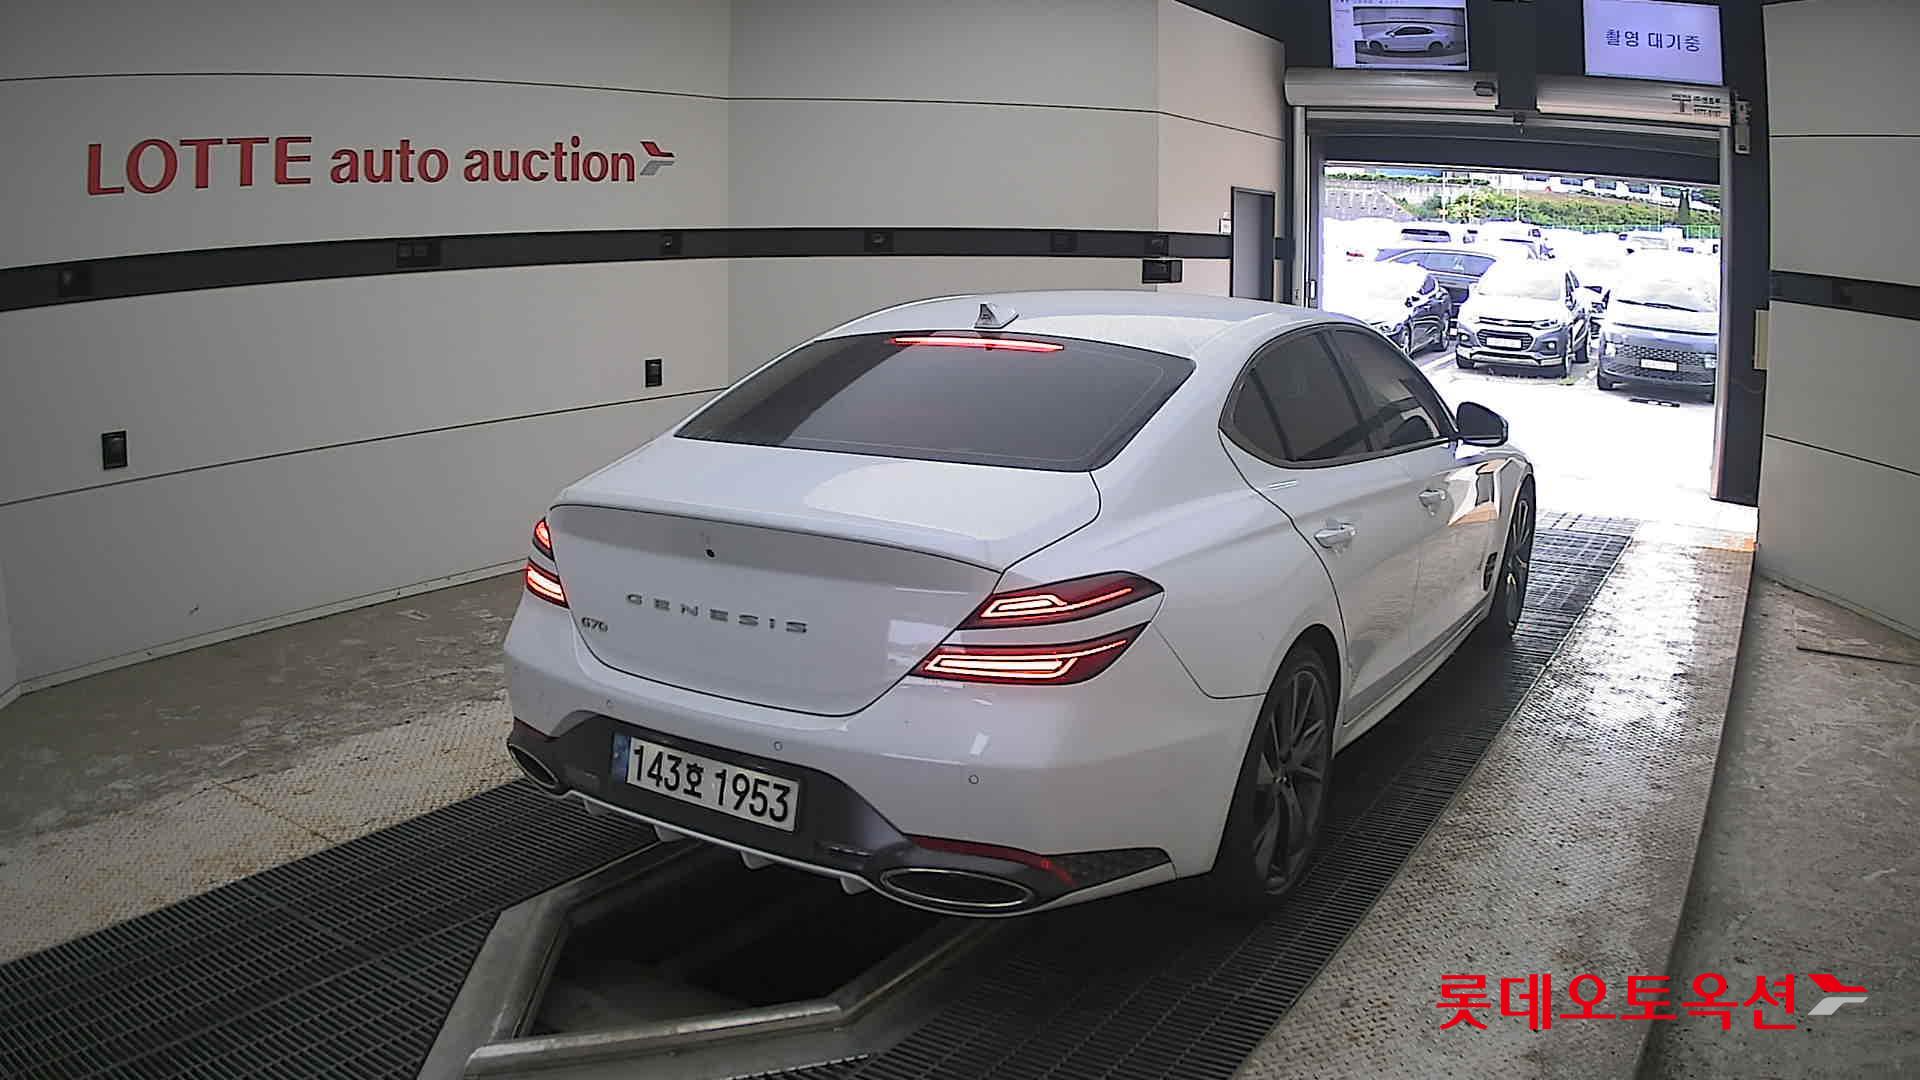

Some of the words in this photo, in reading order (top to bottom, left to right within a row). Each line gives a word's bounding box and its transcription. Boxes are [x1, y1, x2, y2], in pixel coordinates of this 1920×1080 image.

[1647, 32, 1701, 53] 대기중
[87, 135, 312, 196] LOTTE
[329, 139, 449, 184] auto
[463, 135, 636, 183] auction
[581, 616, 609, 633] G70
[626, 593, 808, 634] GENESIS
[634, 745, 704, 799] 143호
[715, 769, 791, 823] 1953
